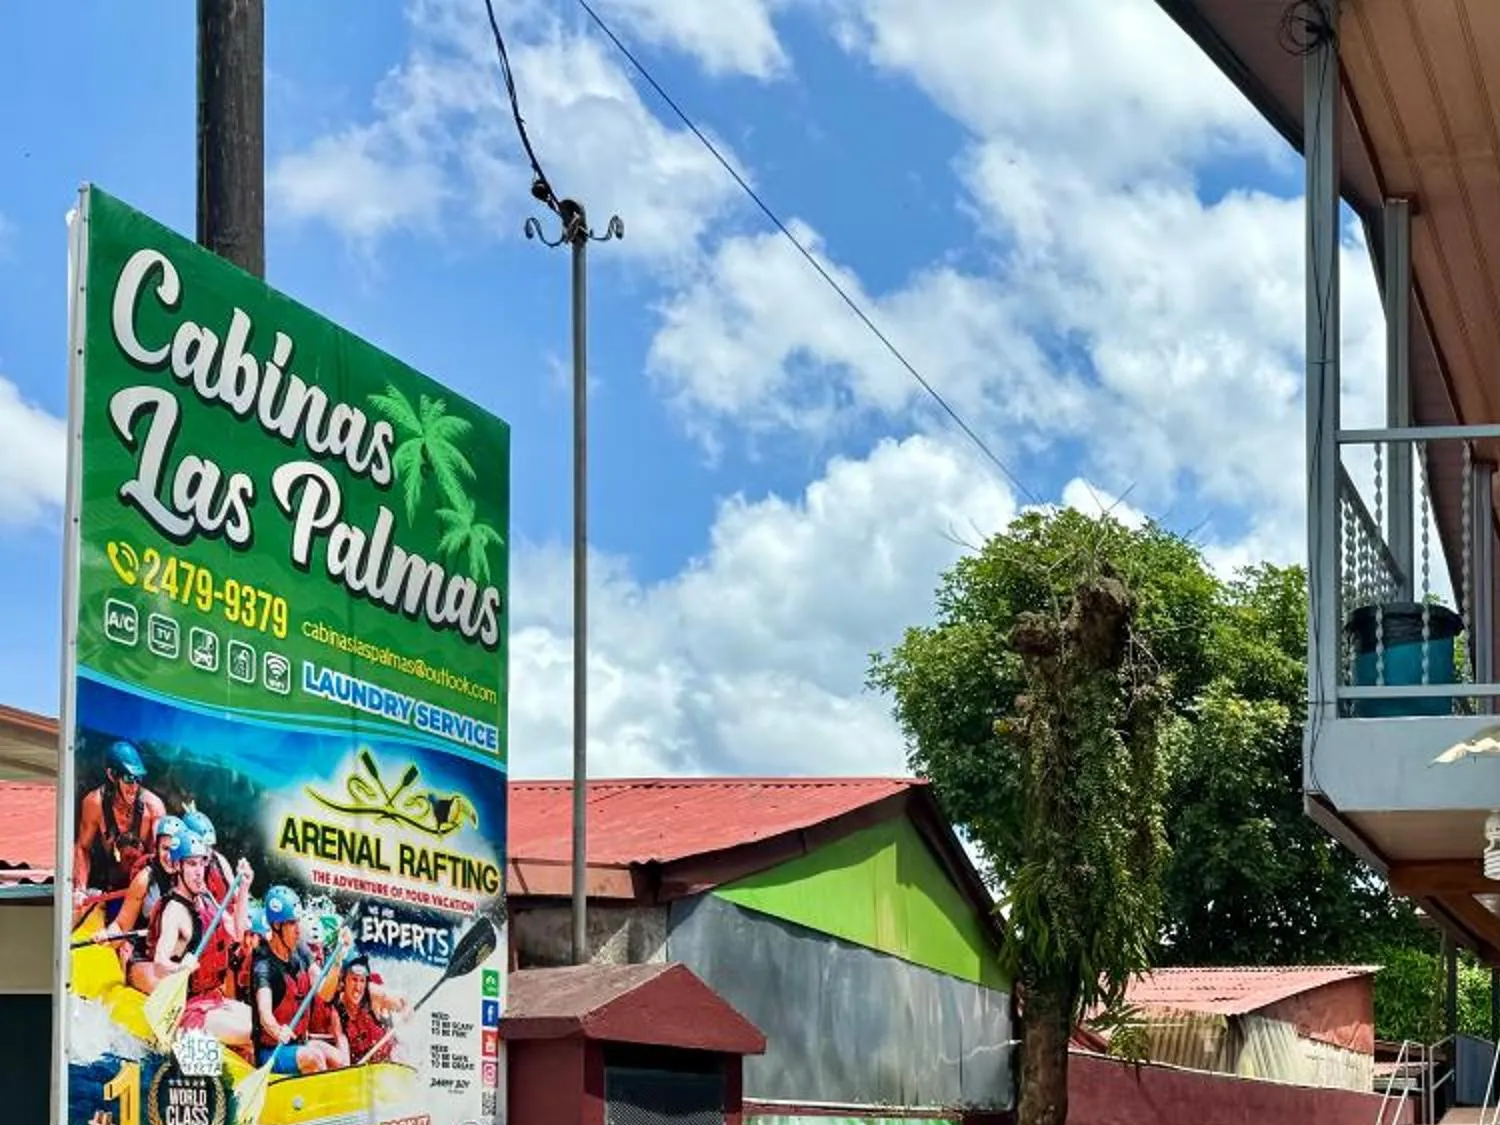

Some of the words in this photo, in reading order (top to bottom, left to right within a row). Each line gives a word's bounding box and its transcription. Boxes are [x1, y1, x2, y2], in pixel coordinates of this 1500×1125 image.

[112, 248, 395, 486] Cabinas
[109, 385, 254, 545] Las
[272, 461, 500, 648] Palmas
[107, 611, 136, 632] A/C
[142, 548, 288, 640] 2479-9379
[303, 620, 498, 704] cabinaslaspalmas@outlook.com
[303, 661, 415, 723] LAUNDRY
[415, 701, 499, 752] SERVICE
[279, 816, 390, 871] ARENAL
[399, 843, 499, 894] RAFTING
[312, 869, 331, 885] THE
[332, 875, 388, 896] ADVENTURE
[361, 916, 449, 957] EXPERTS
[168, 1088, 207, 1106] WORLD
